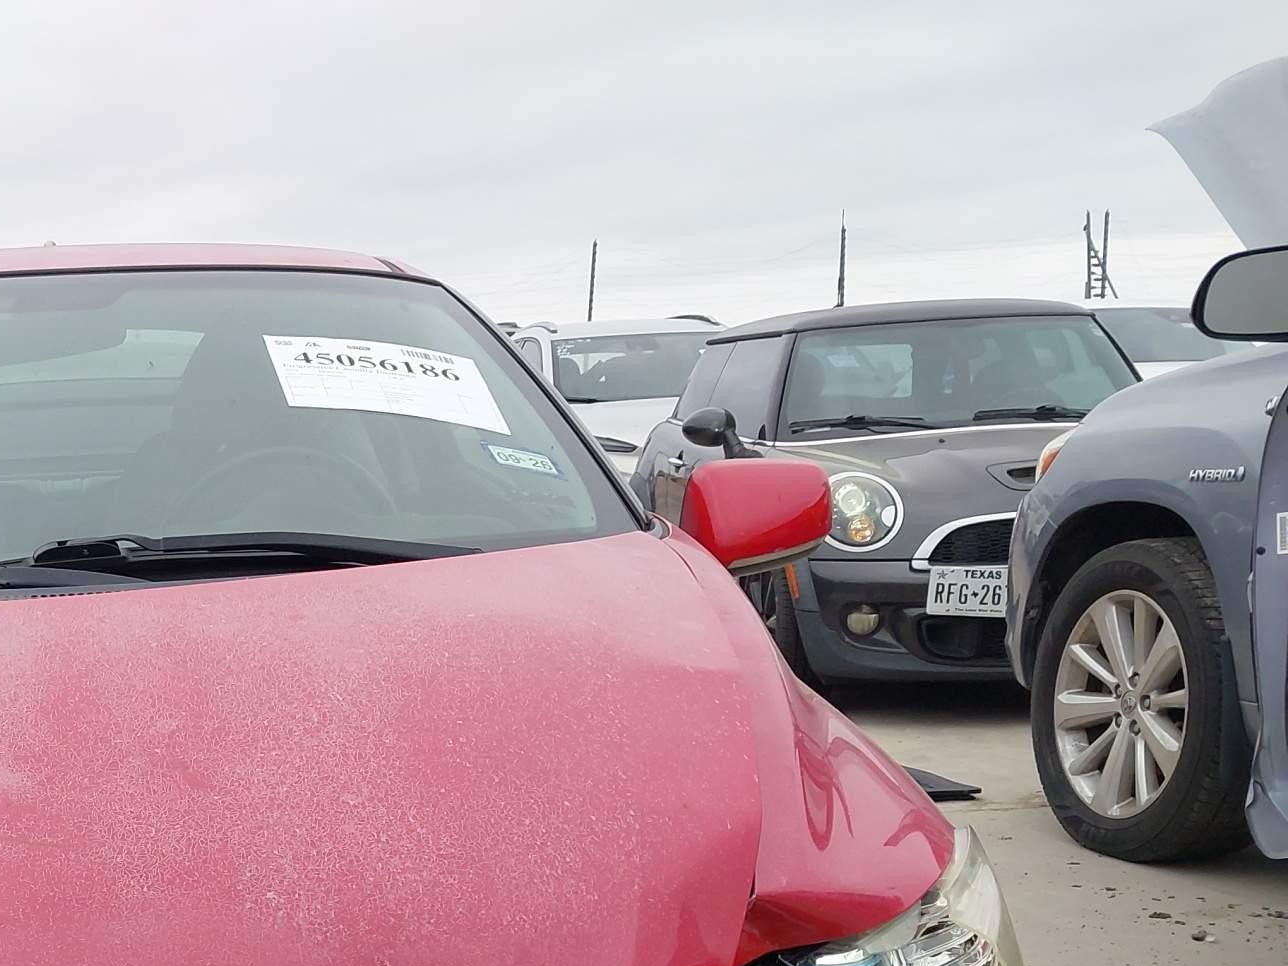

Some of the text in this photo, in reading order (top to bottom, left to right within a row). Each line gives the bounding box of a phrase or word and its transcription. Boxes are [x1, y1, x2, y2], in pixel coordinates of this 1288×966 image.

[294, 351, 461, 382] 45056186
[1189, 469, 1235, 481] HYBRID
[964, 569, 1002, 580] TEXAS
[934, 582, 1008, 606] RFG 26
